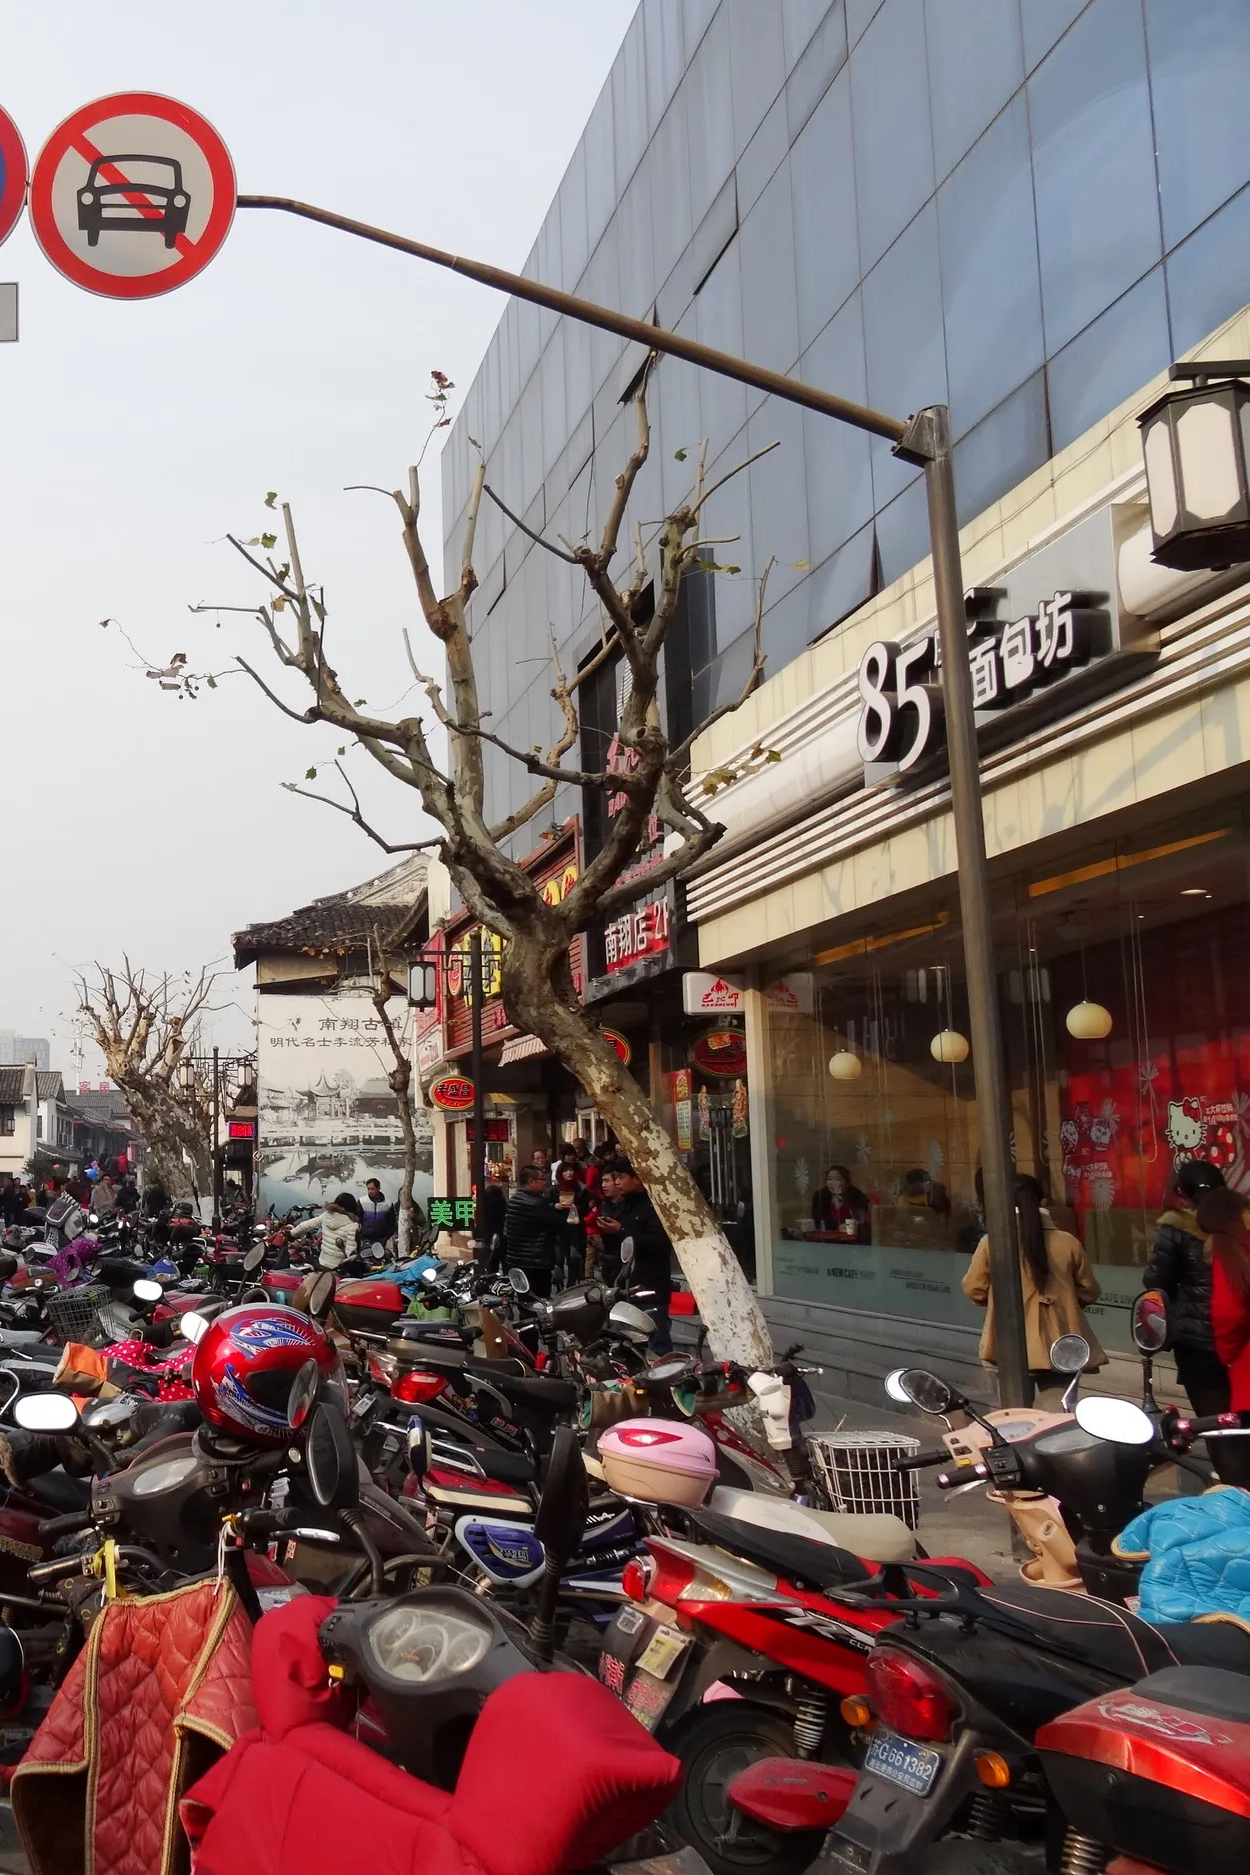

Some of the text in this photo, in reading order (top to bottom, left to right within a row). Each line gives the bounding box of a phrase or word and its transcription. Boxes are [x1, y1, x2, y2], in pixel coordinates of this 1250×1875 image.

[604, 908, 647, 965] 南翔店
[318, 1017, 404, 1031] 南翔古镇
[430, 1200, 475, 1227] 美甲
